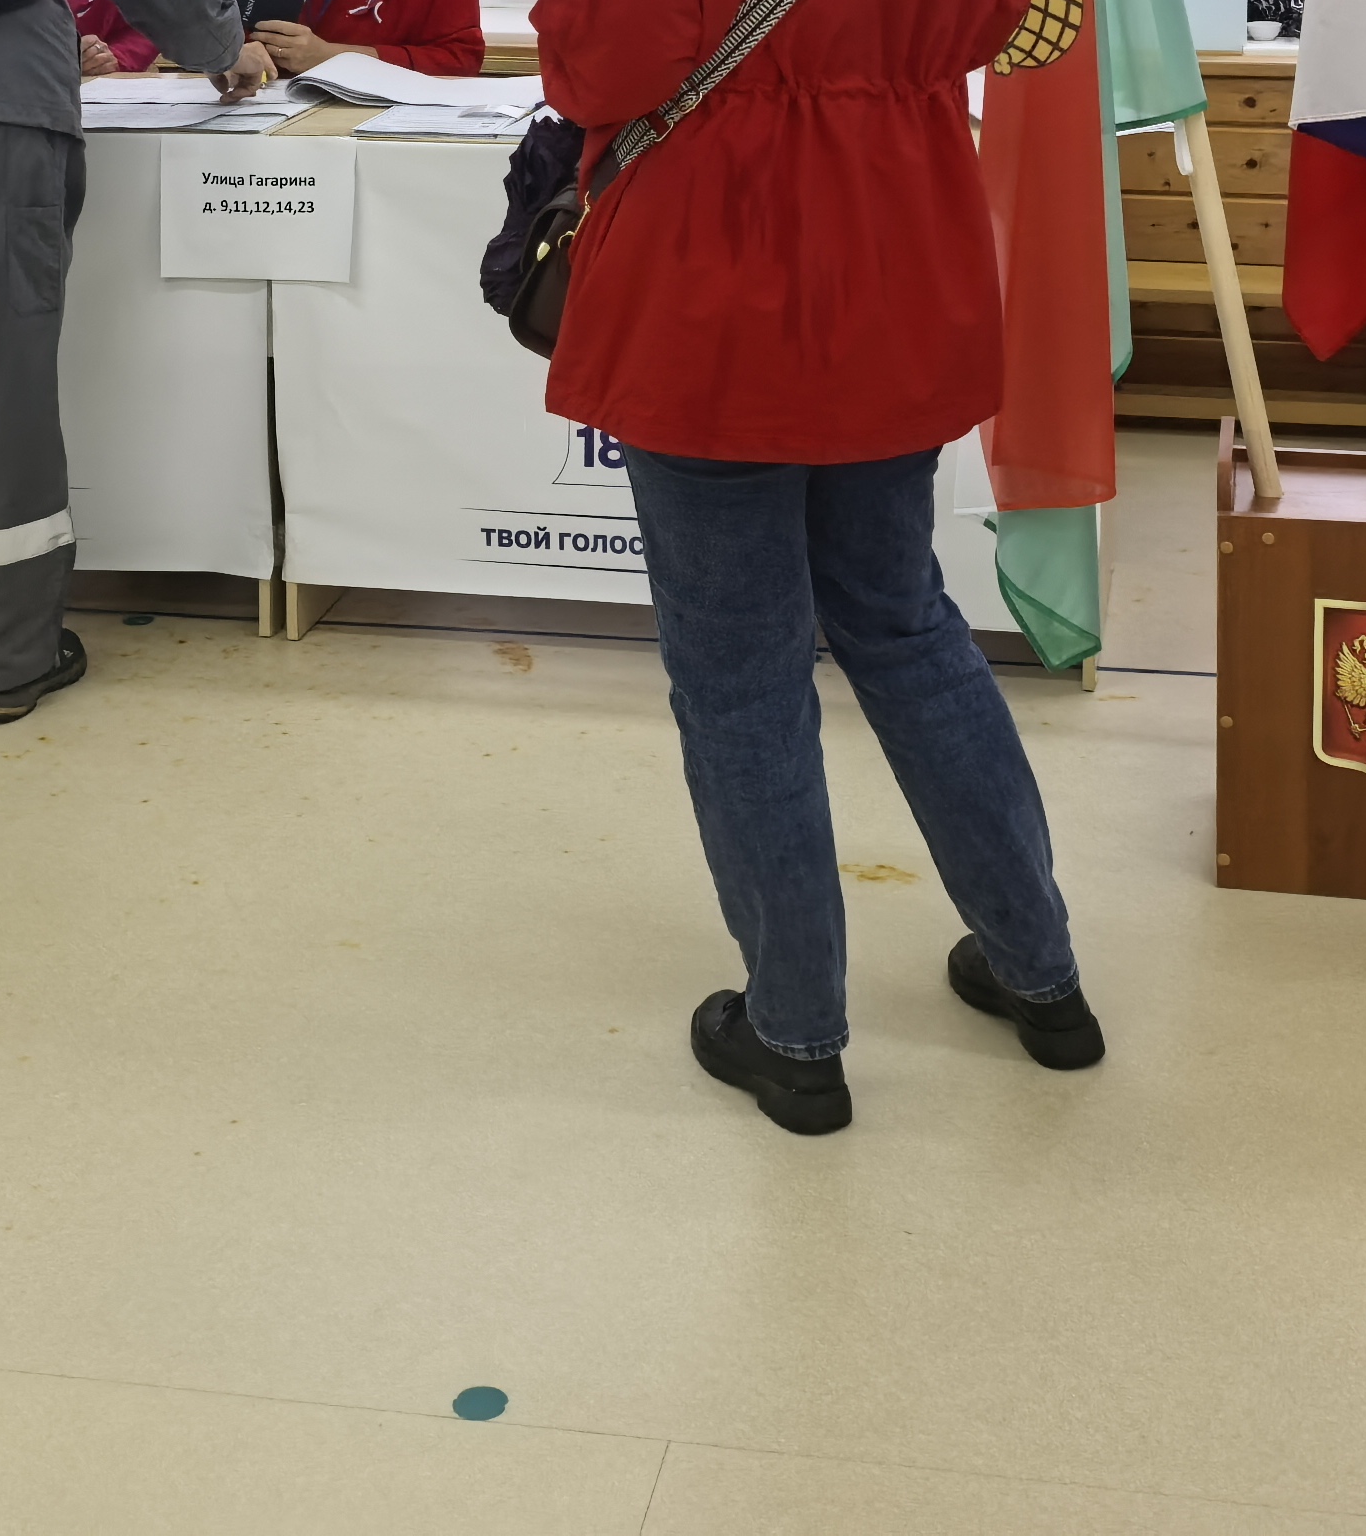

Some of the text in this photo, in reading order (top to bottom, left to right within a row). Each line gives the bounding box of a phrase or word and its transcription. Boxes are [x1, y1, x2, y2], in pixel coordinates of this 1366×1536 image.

[201, 171, 316, 189] Улица Гагарина
[202, 199, 315, 215] д. 9,11,12,14,23
[481, 526, 644, 555] ТВОЙ ГОЛОС
